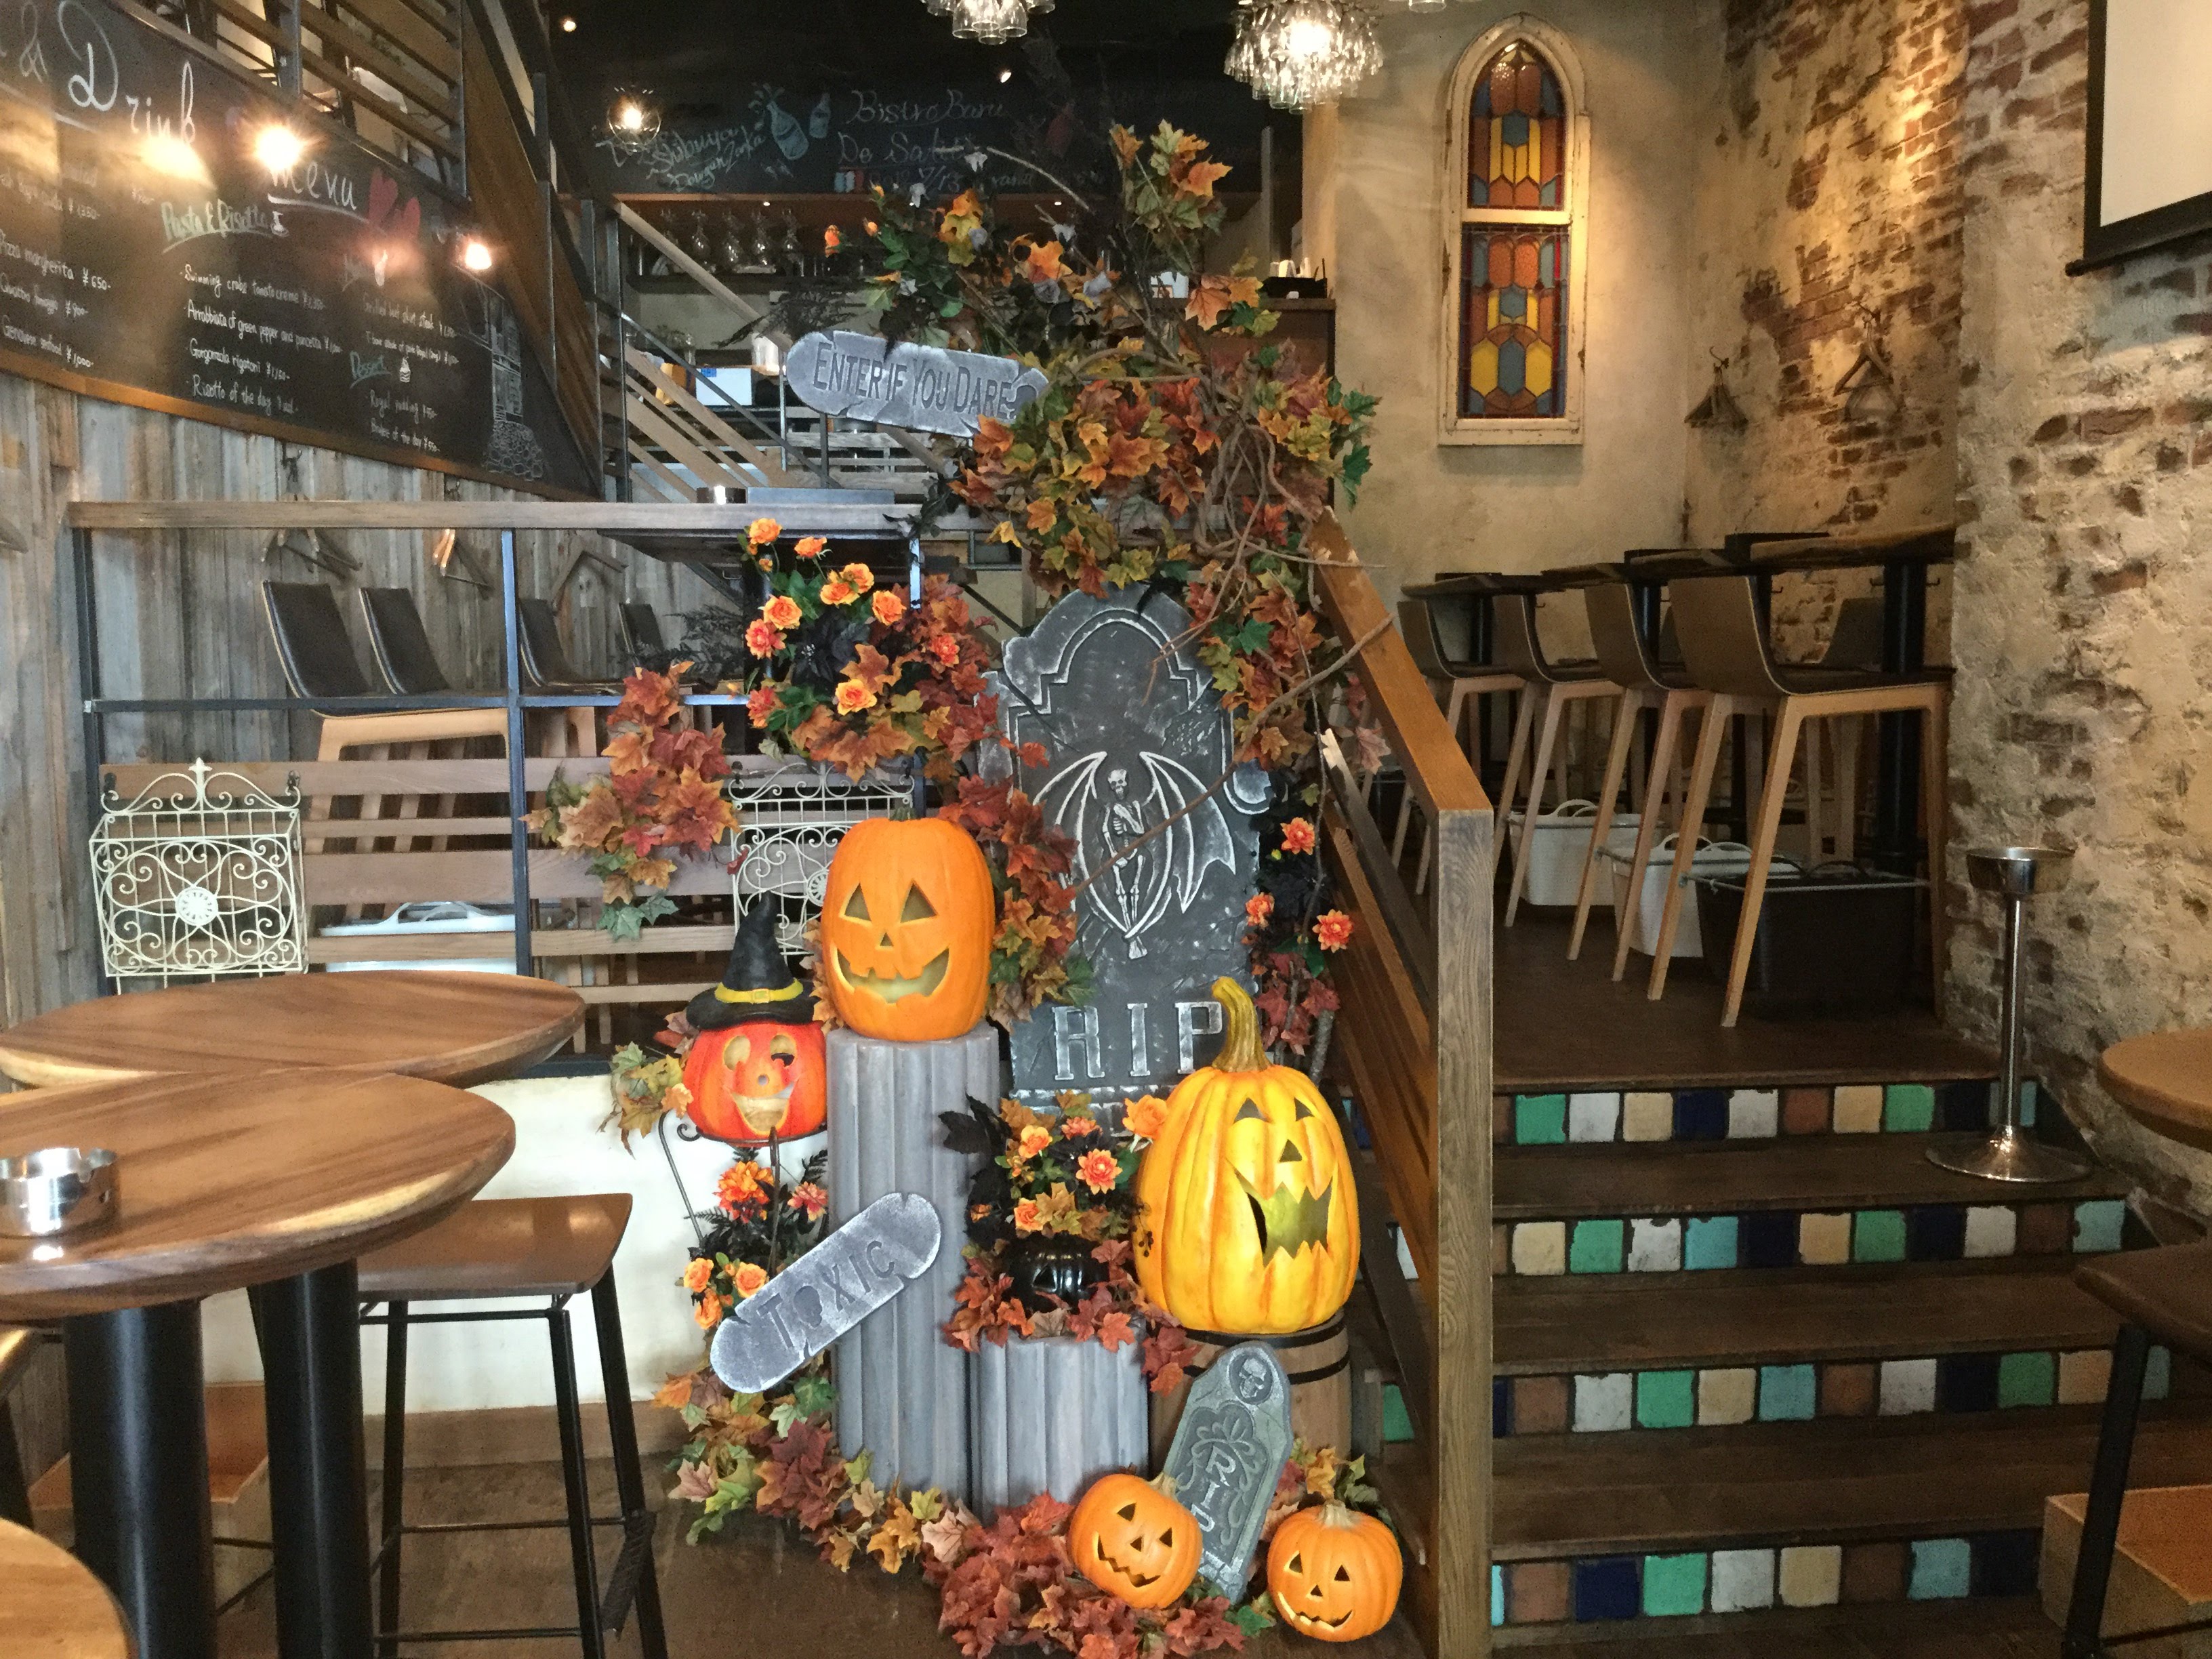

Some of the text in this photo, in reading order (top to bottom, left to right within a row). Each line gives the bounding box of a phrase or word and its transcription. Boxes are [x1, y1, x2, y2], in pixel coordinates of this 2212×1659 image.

[229, 382, 238, 403] of
[241, 386, 254, 405] the
[813, 342, 882, 399] ENTER
[885, 363, 908, 402] IF
[912, 358, 949, 411] YOU
[756, 1240, 895, 1351] TOXIC
